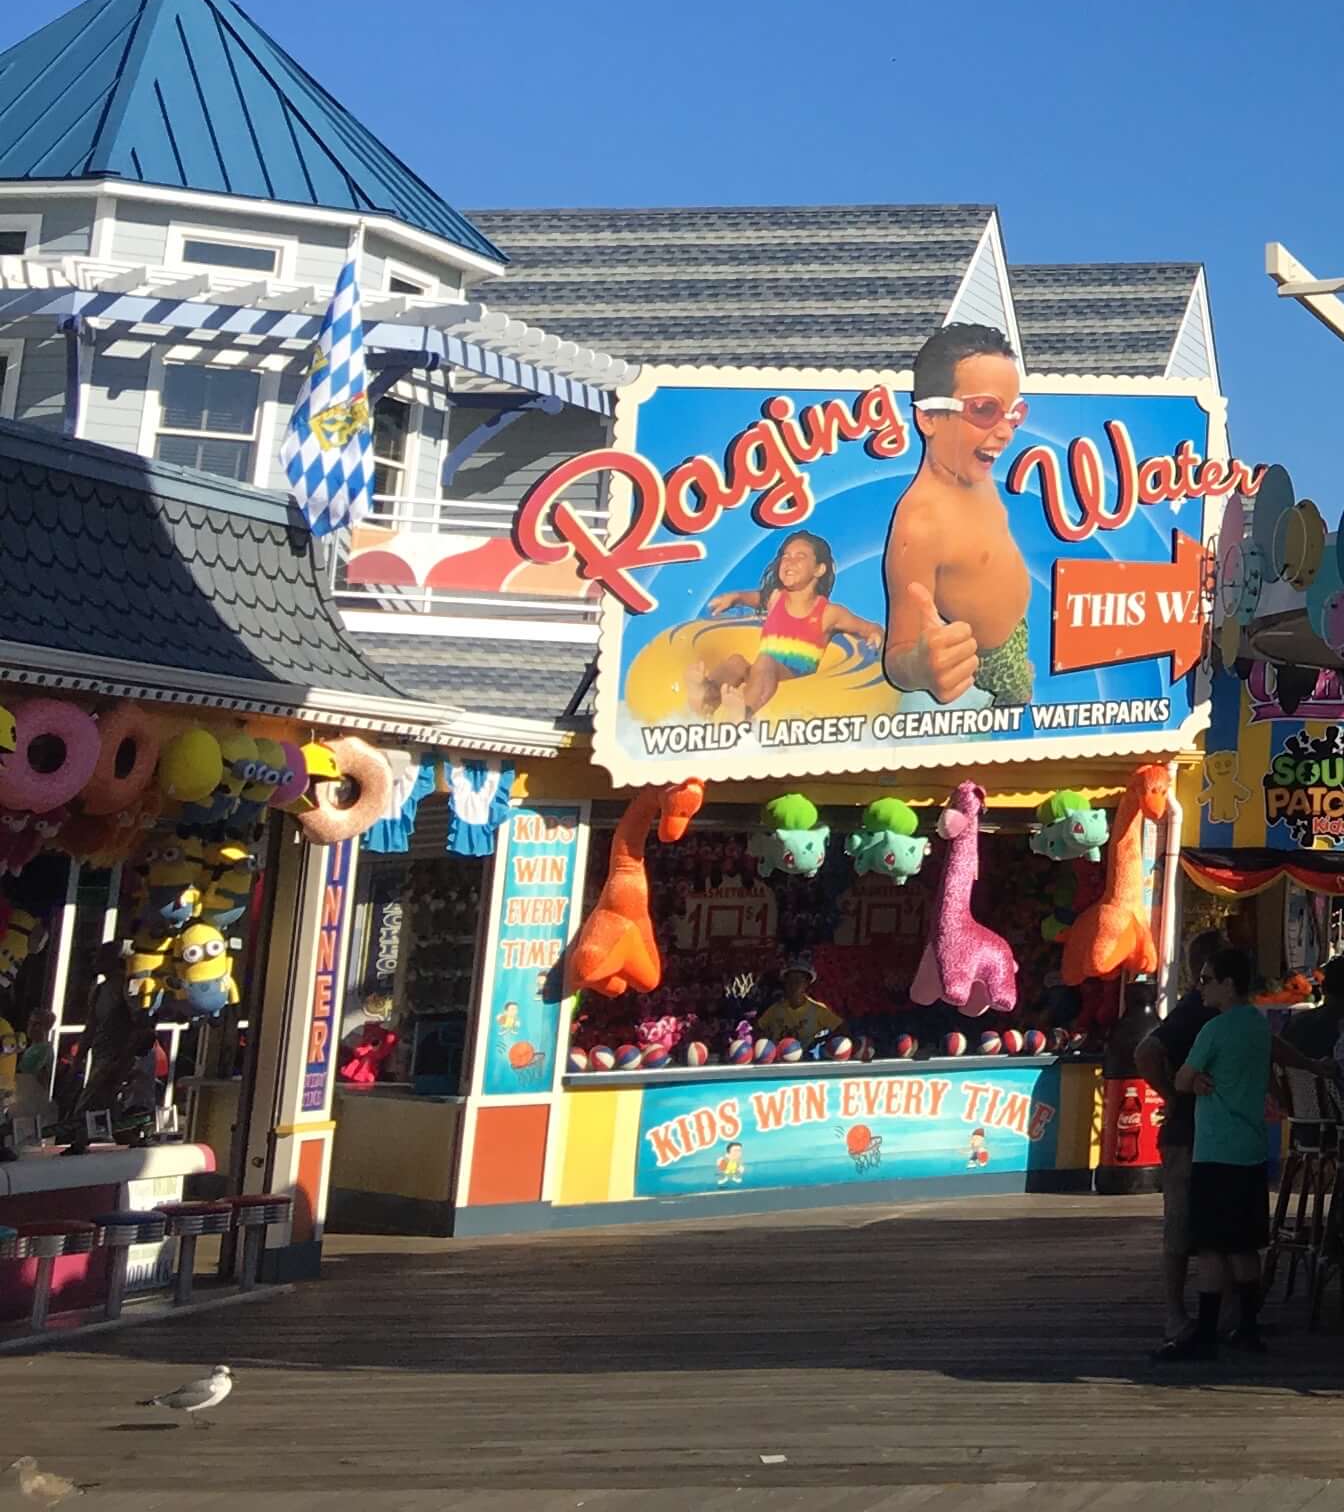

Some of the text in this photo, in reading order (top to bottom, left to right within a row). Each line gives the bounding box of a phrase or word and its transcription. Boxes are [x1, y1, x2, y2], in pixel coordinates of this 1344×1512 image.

[514, 385, 1268, 614] Raging Water
[1066, 591, 1146, 627] THIS
[759, 717, 864, 748] LARGEST
[873, 707, 1024, 739] OCEANFRONT
[1031, 698, 1170, 730] WATERPARKS
[514, 815, 574, 843] KIDS
[512, 856, 565, 884] WIN
[506, 897, 569, 925] EVERY
[501, 940, 561, 968] TIME
[646, 1075, 1056, 1167] KIDS WIN EVERY TIME
